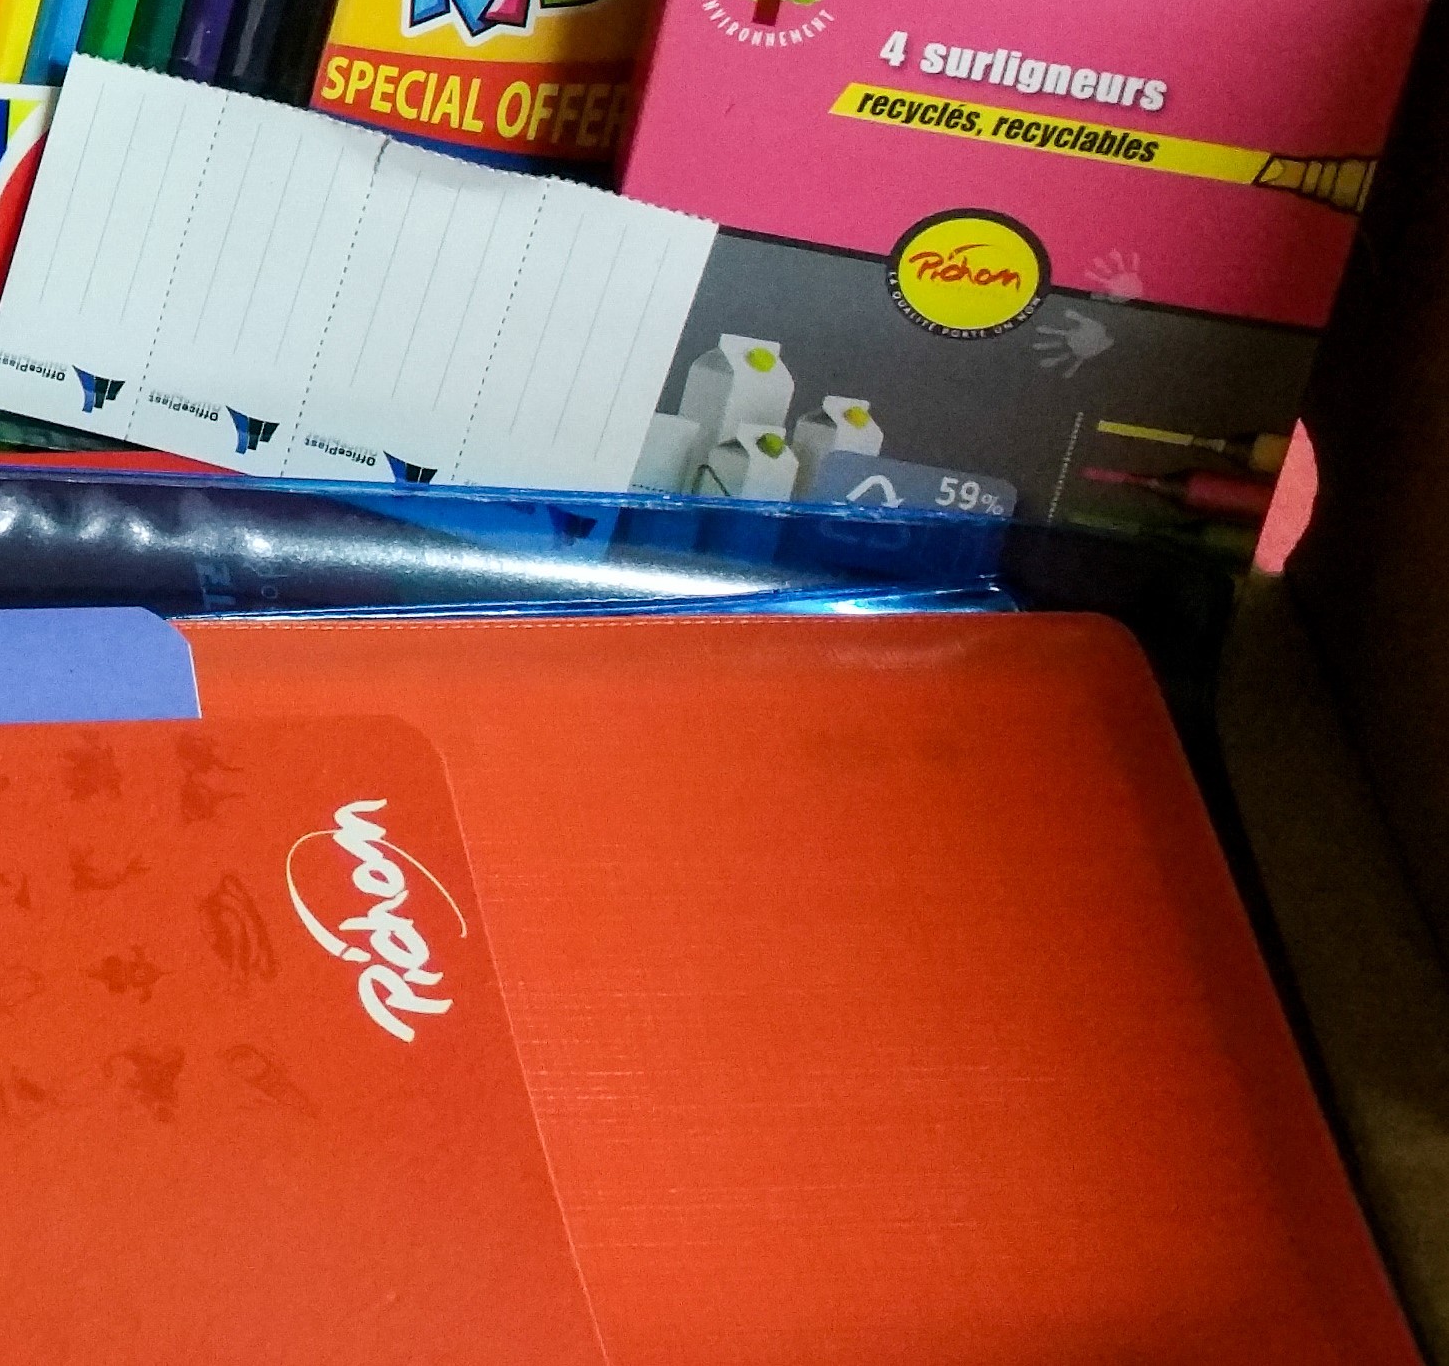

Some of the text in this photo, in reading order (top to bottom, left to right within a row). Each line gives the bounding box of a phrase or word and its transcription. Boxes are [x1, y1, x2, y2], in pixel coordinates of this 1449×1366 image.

[320, 56, 485, 135] SPECIAL
[879, 29, 1168, 114] 4 surligneurs
[855, 88, 1161, 165] recyclés, recyclables
[147, 391, 220, 423] OfficePlast
[303, 435, 378, 468] OfficePlast
[934, 475, 1004, 516] 59%
